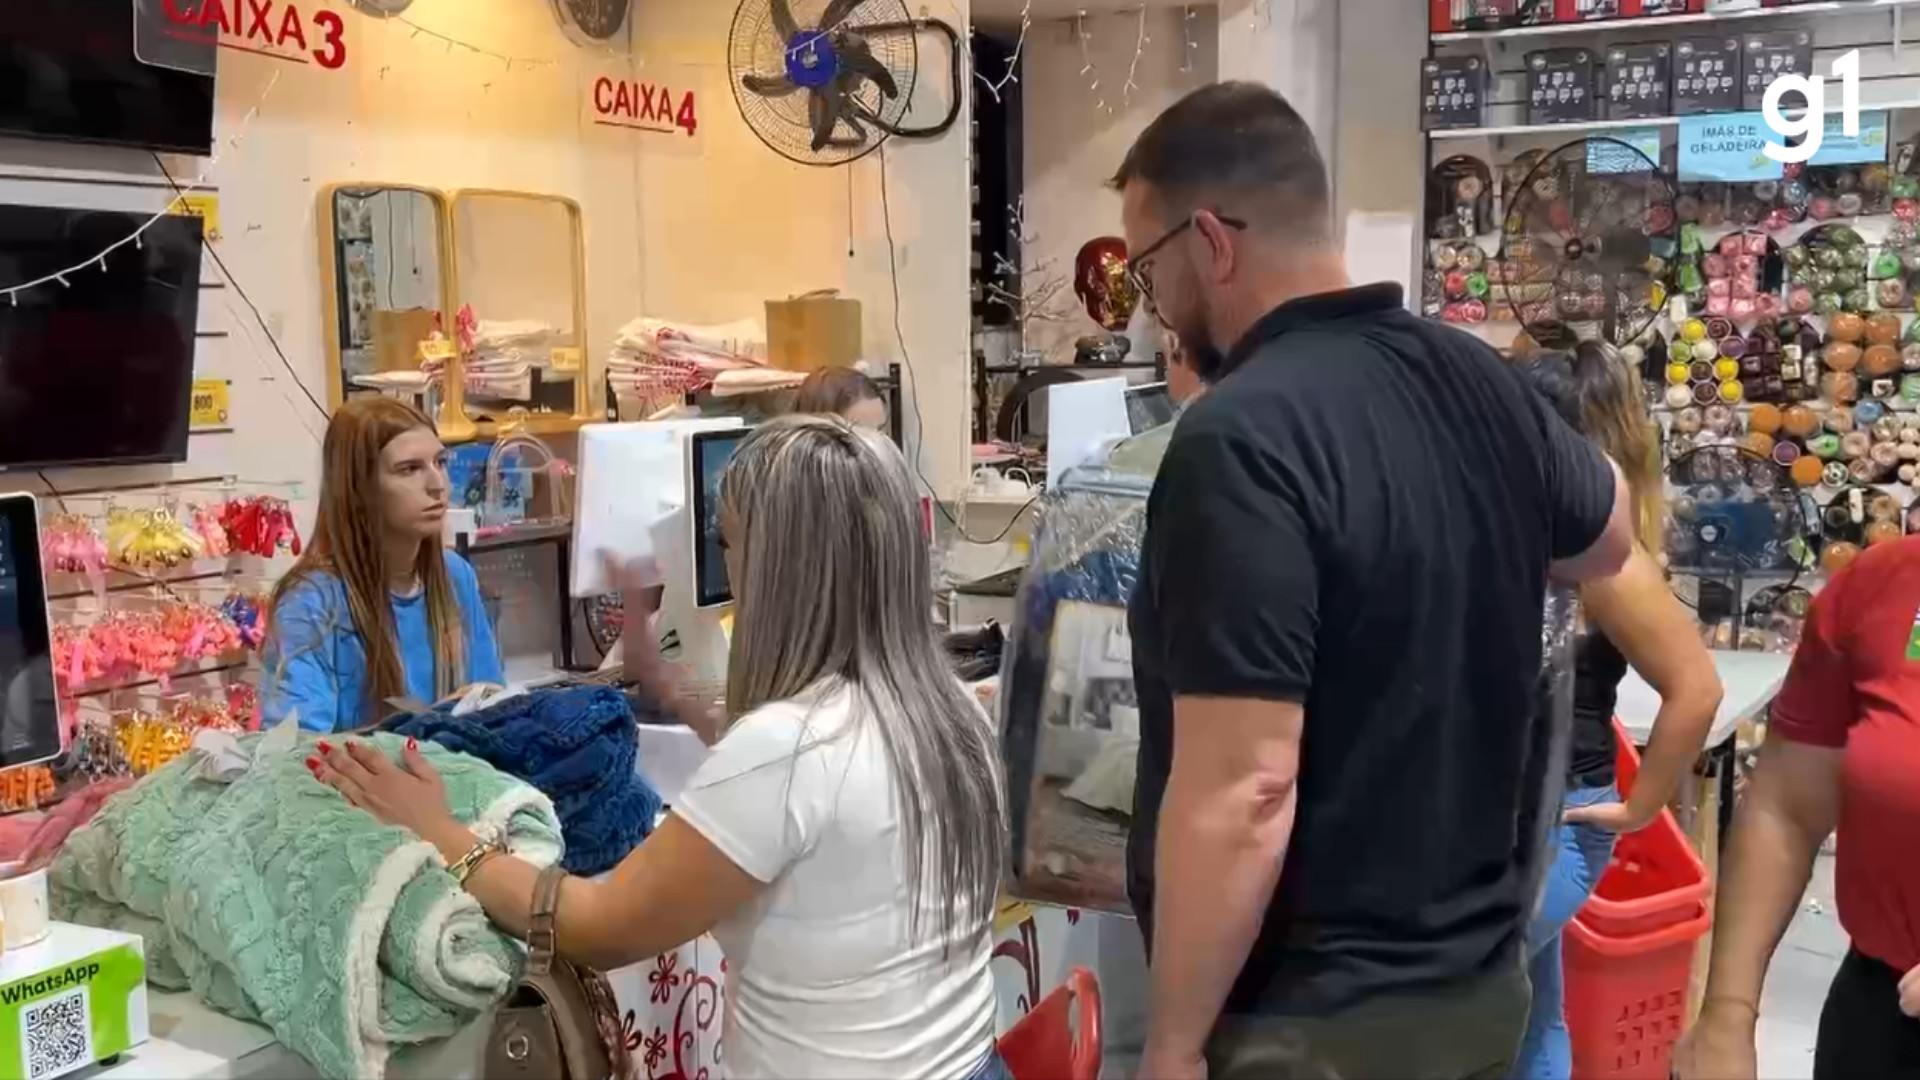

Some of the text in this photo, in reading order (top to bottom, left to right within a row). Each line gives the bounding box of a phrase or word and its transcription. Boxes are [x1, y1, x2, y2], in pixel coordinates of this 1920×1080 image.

[161, 0, 346, 69] CAIXA 3
[594, 77, 697, 137] CAIXA 4
[1738, 125, 1757, 136] DE
[1, 962, 100, 1004] WhatsApp
